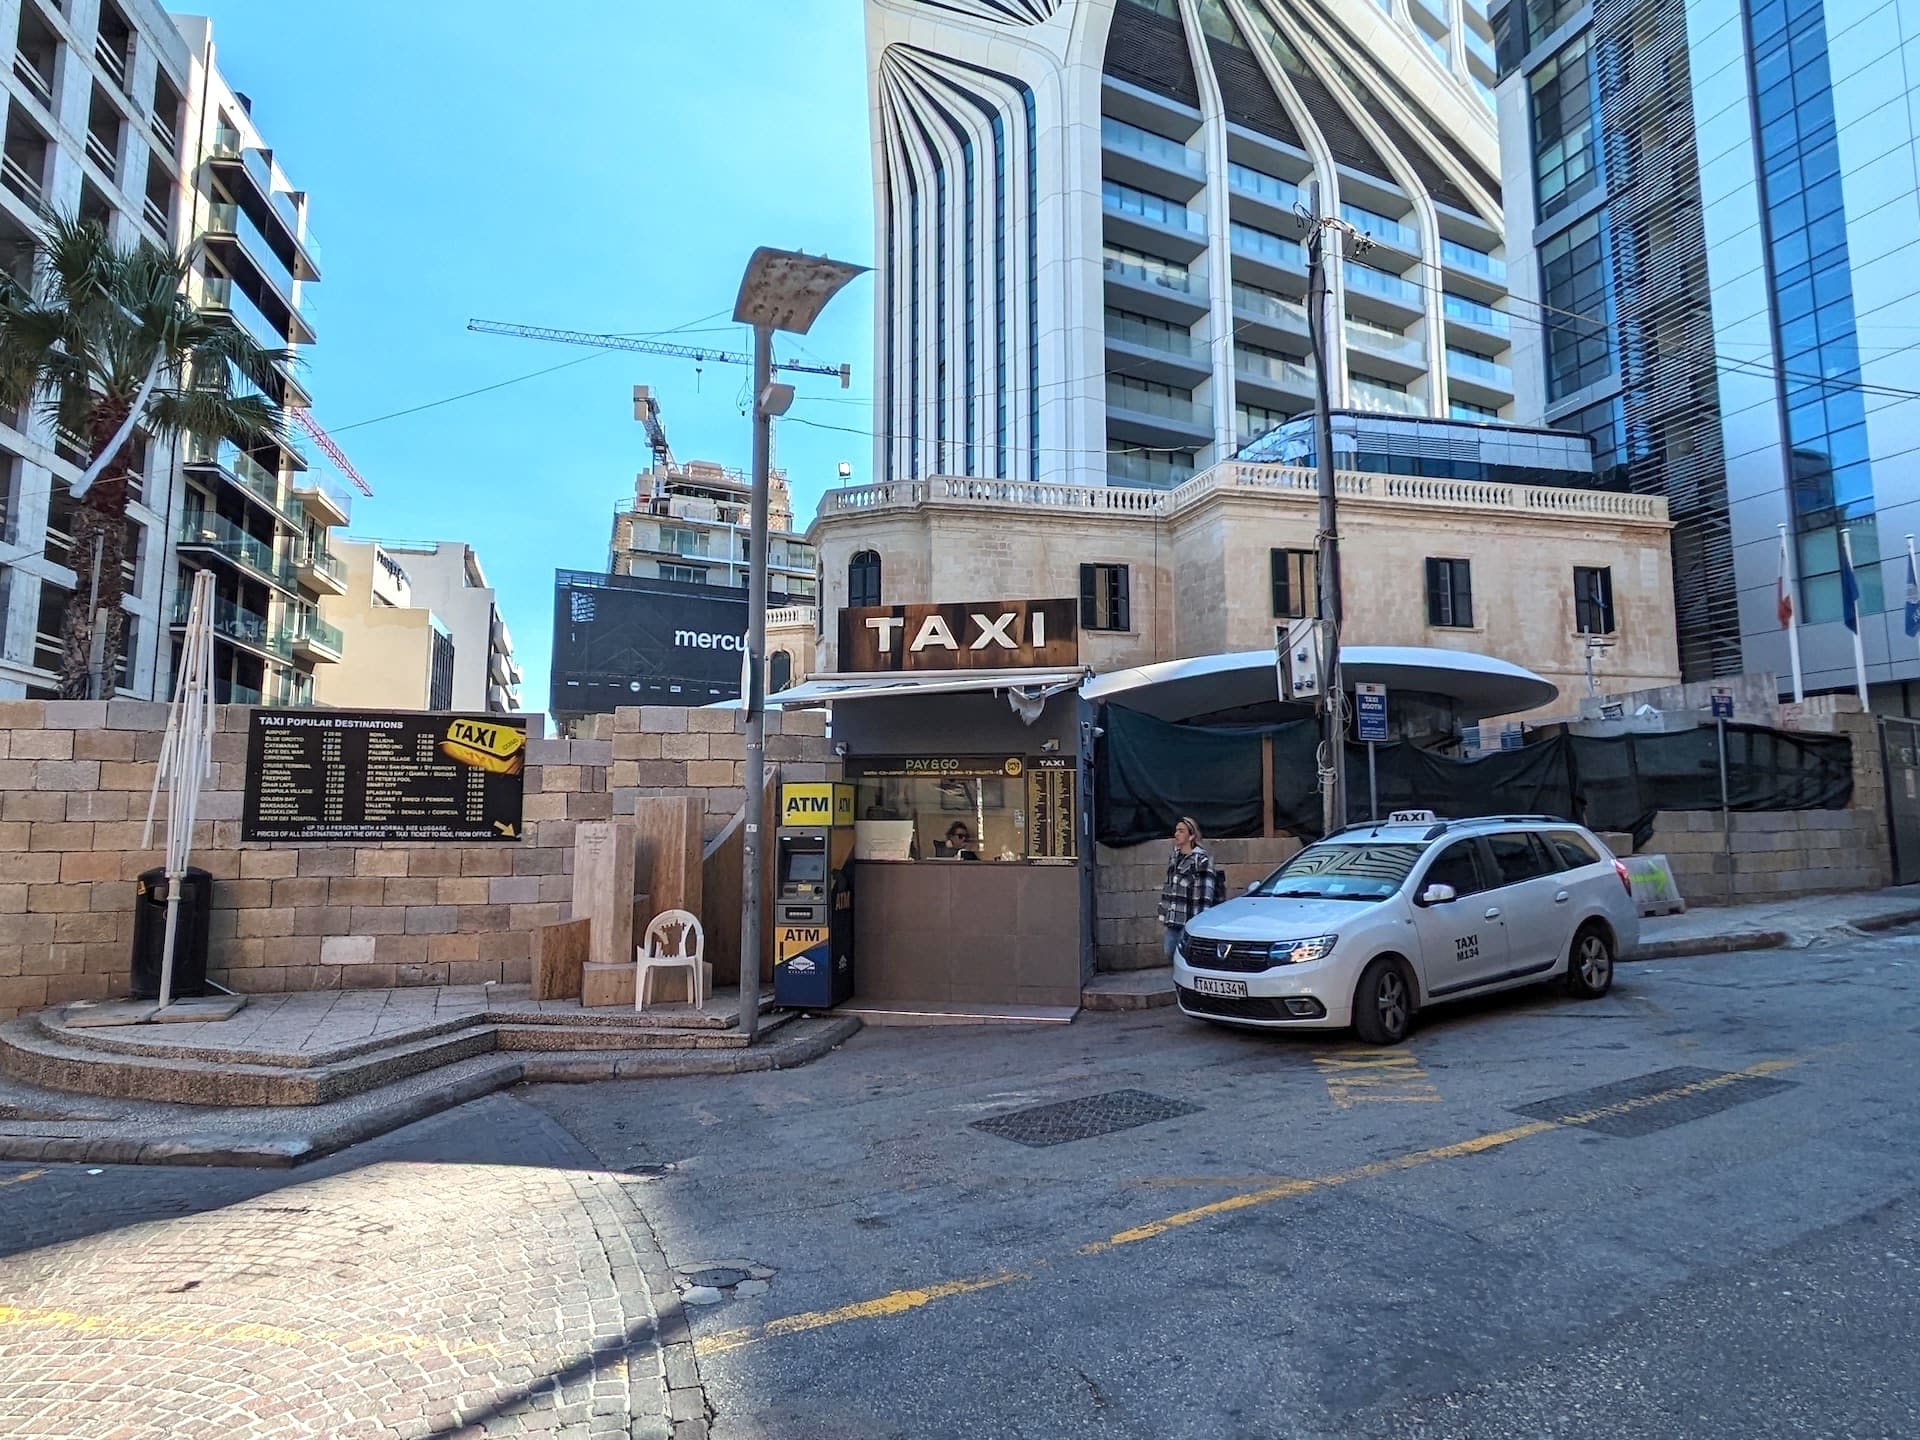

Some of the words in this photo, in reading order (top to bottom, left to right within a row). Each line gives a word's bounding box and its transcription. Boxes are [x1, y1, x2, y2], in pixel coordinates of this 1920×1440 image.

[865, 611, 1046, 653] TAXI
[259, 717, 284, 726] TAXI
[286, 717, 333, 728] POPULAR
[335, 719, 403, 729] DESTINATIONS
[455, 723, 497, 749] TAXI
[786, 797, 829, 812] ATM
[1392, 813, 1425, 822] TAXI
[784, 929, 820, 942] ATM
[1455, 934, 1478, 950] TAXI
[1457, 947, 1479, 961] M134
